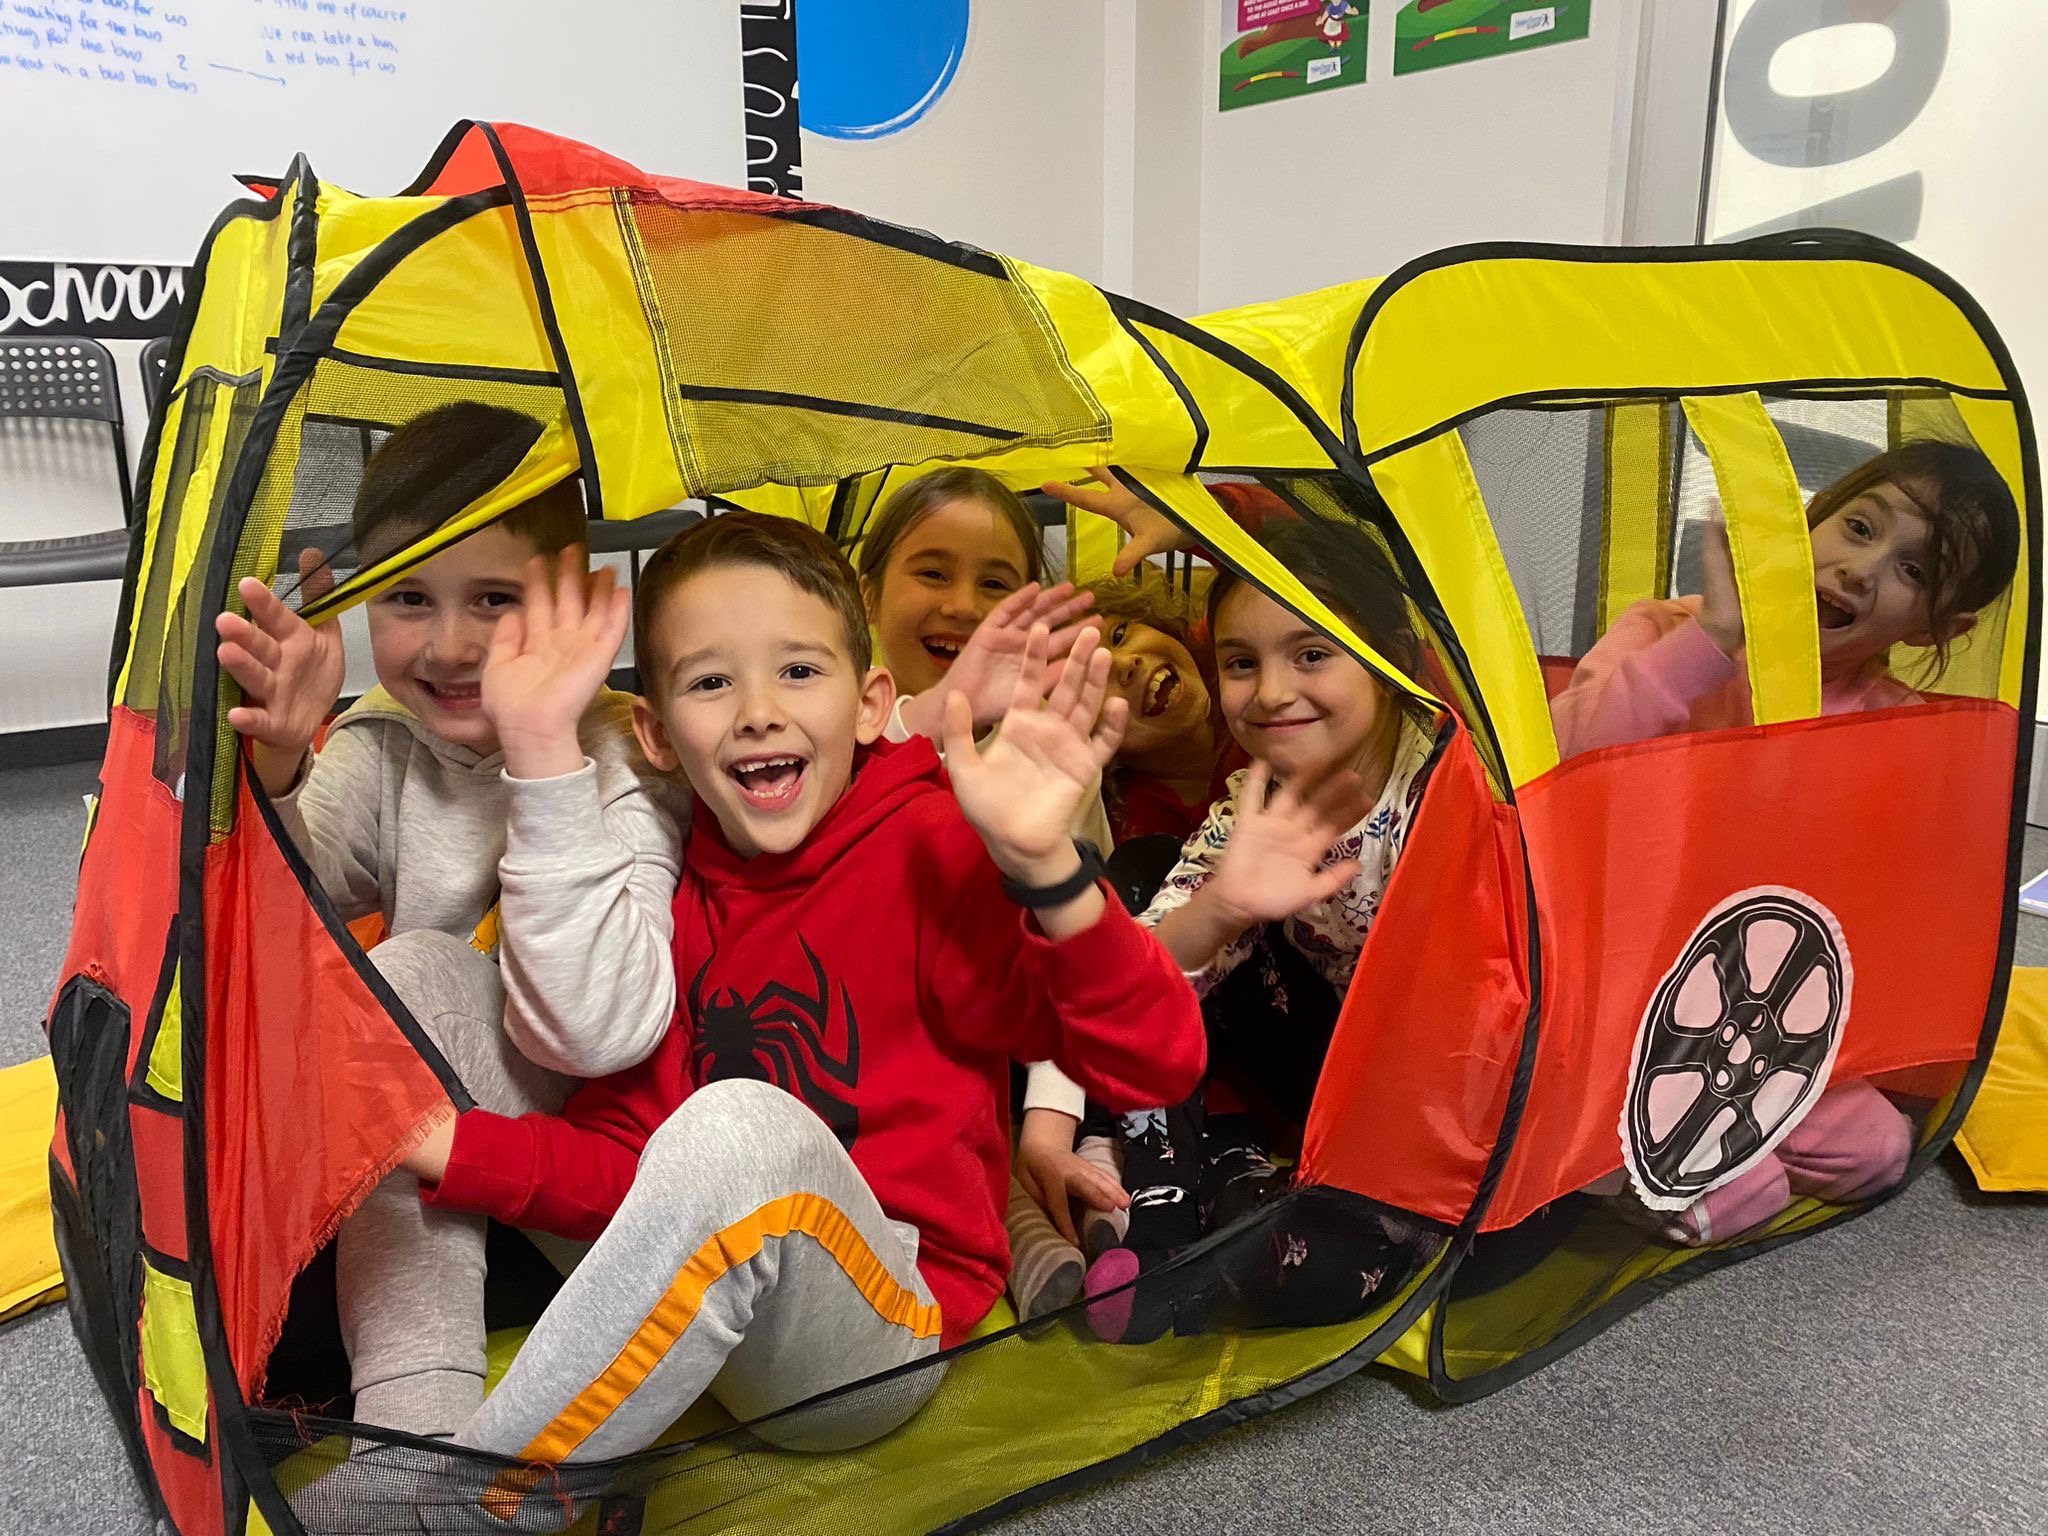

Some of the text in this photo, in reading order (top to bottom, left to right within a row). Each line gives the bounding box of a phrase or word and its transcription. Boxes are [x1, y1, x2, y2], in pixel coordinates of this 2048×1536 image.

[13, 4, 72, 33] waiting
[133, 23, 163, 43] bus
[361, 6, 406, 22] course
[111, 39, 143, 63] bus
[314, 50, 340, 66] bus
[98, 63, 126, 82] bus
